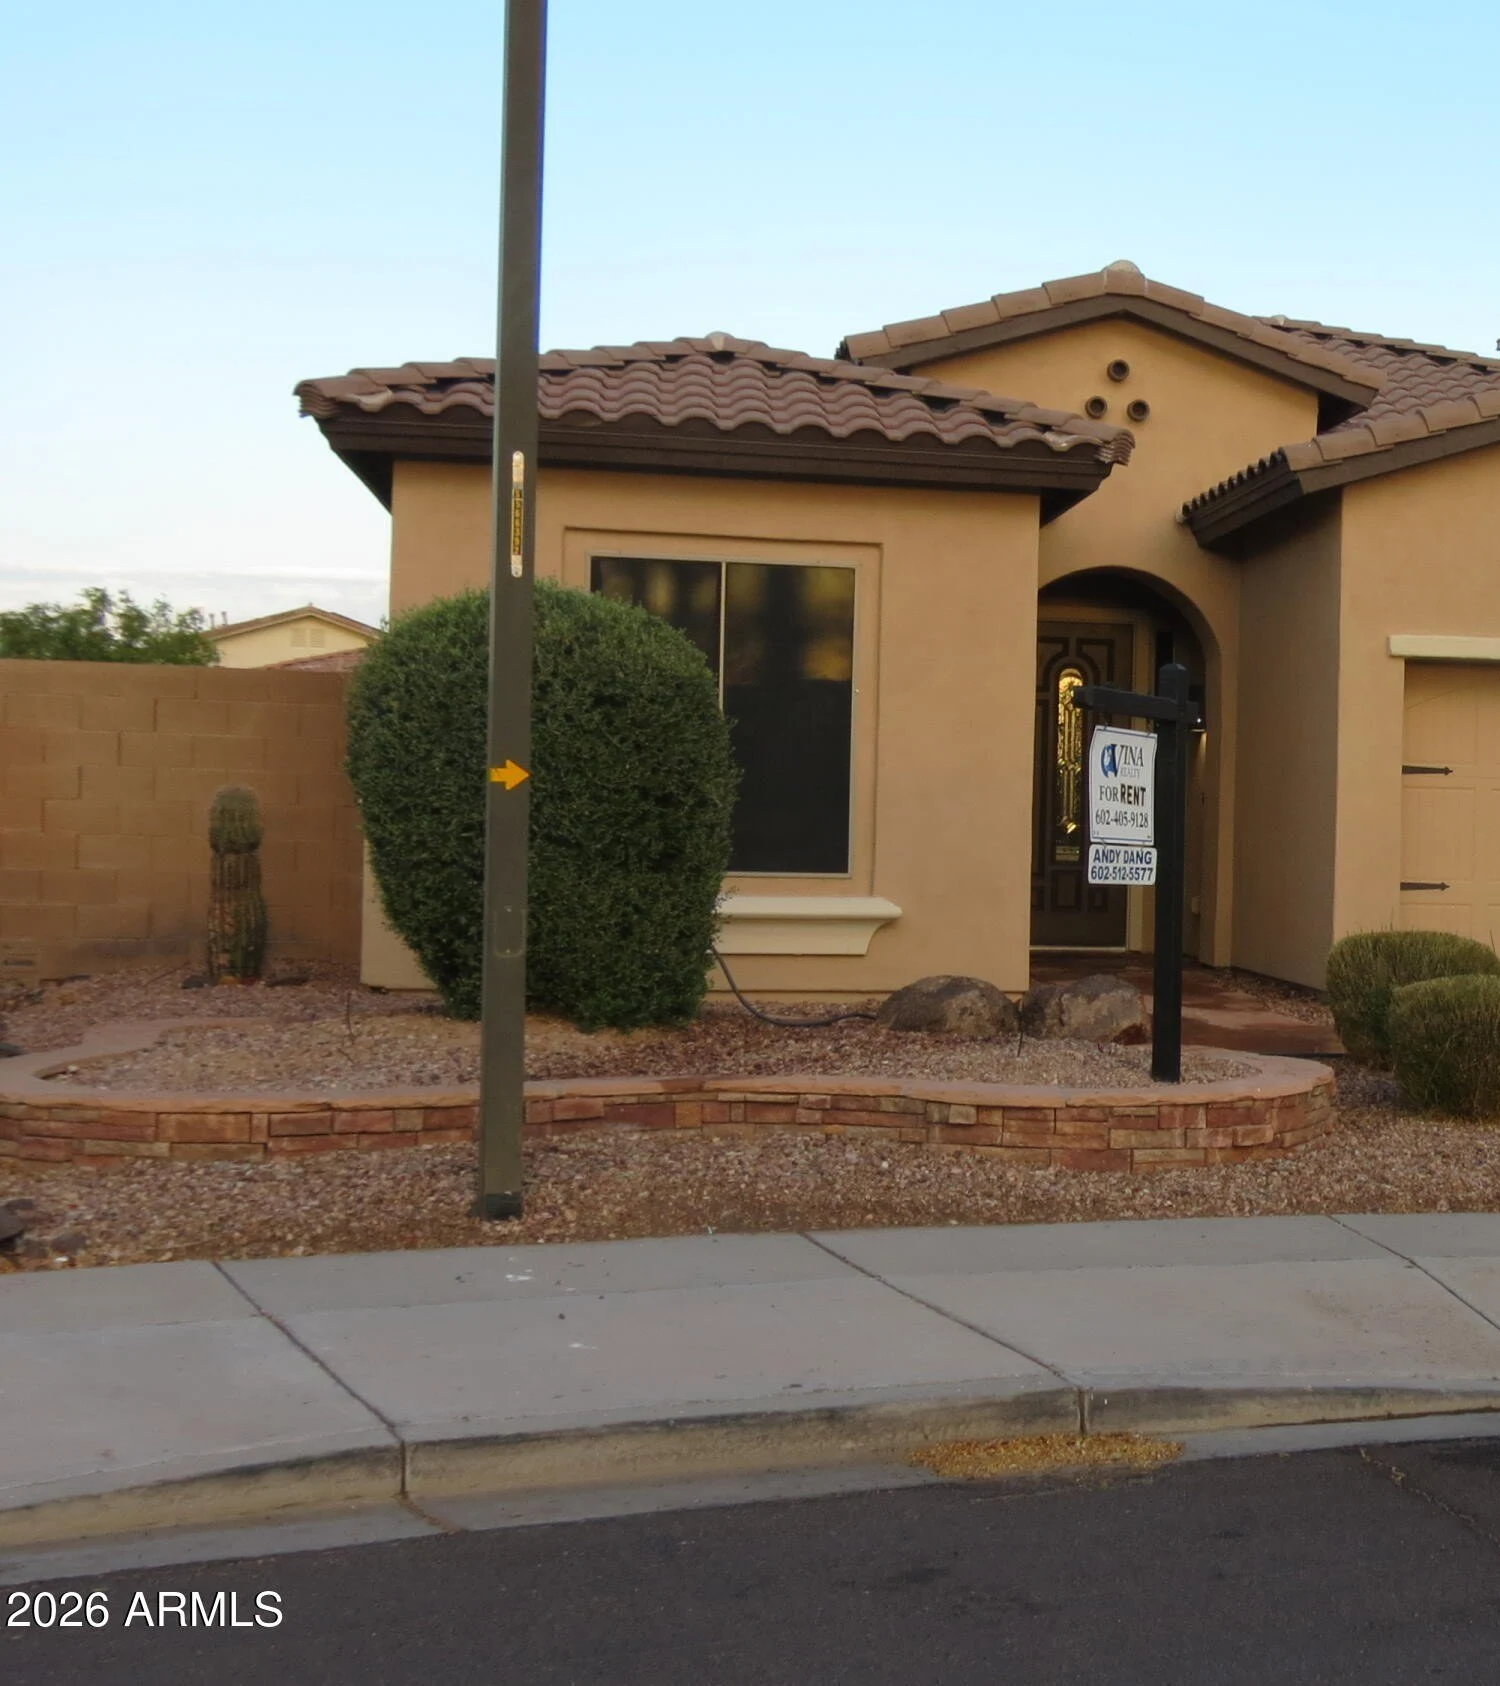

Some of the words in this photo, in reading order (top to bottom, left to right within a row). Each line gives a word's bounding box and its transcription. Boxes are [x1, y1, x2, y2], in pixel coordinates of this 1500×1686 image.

[1110, 744, 1144, 777] VINA
[1099, 785, 1119, 801] FOR
[1120, 784, 1146, 806] RENT
[1093, 849, 1121, 864] ANDY
[1123, 850, 1152, 864] DANG
[1091, 865, 1153, 881] 602-512-5577
